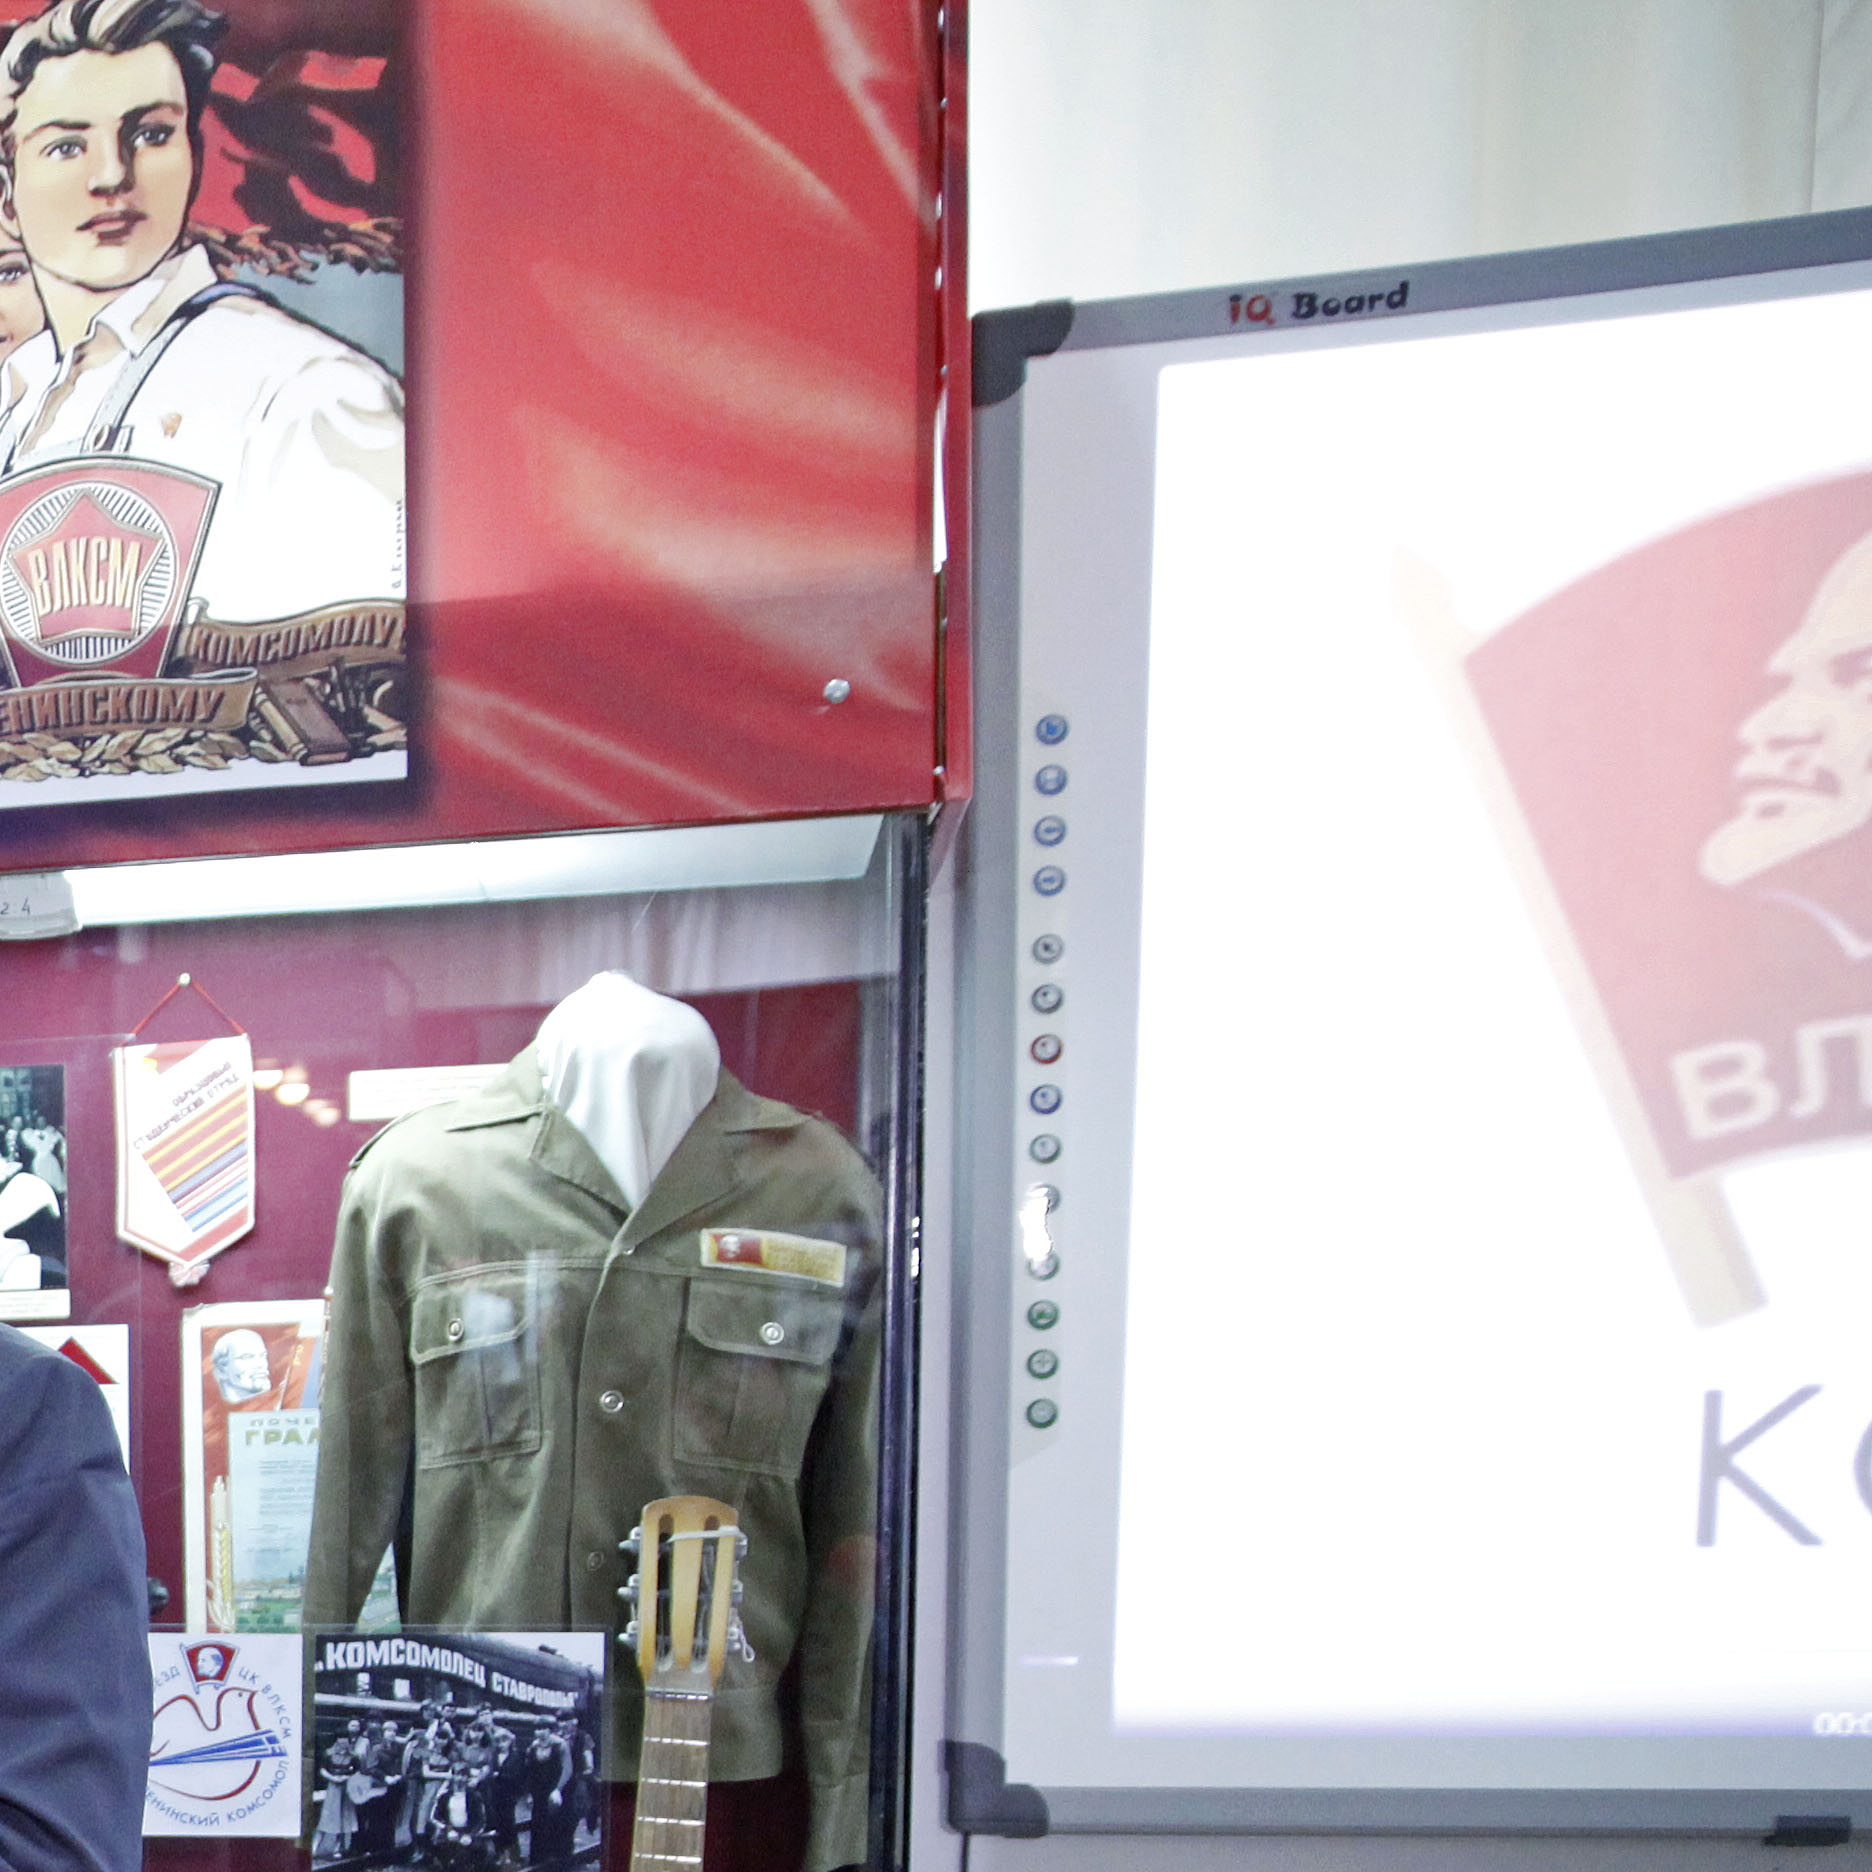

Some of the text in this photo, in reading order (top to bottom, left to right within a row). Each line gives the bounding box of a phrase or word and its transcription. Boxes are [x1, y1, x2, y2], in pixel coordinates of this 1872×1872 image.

[1290, 280, 1411, 321] Board
[27, 535, 143, 616] ВЛКСМ
[187, 612, 393, 666] КОМСОМОЛУ
[226, 1759, 290, 1822] КОМСОМОЛ
